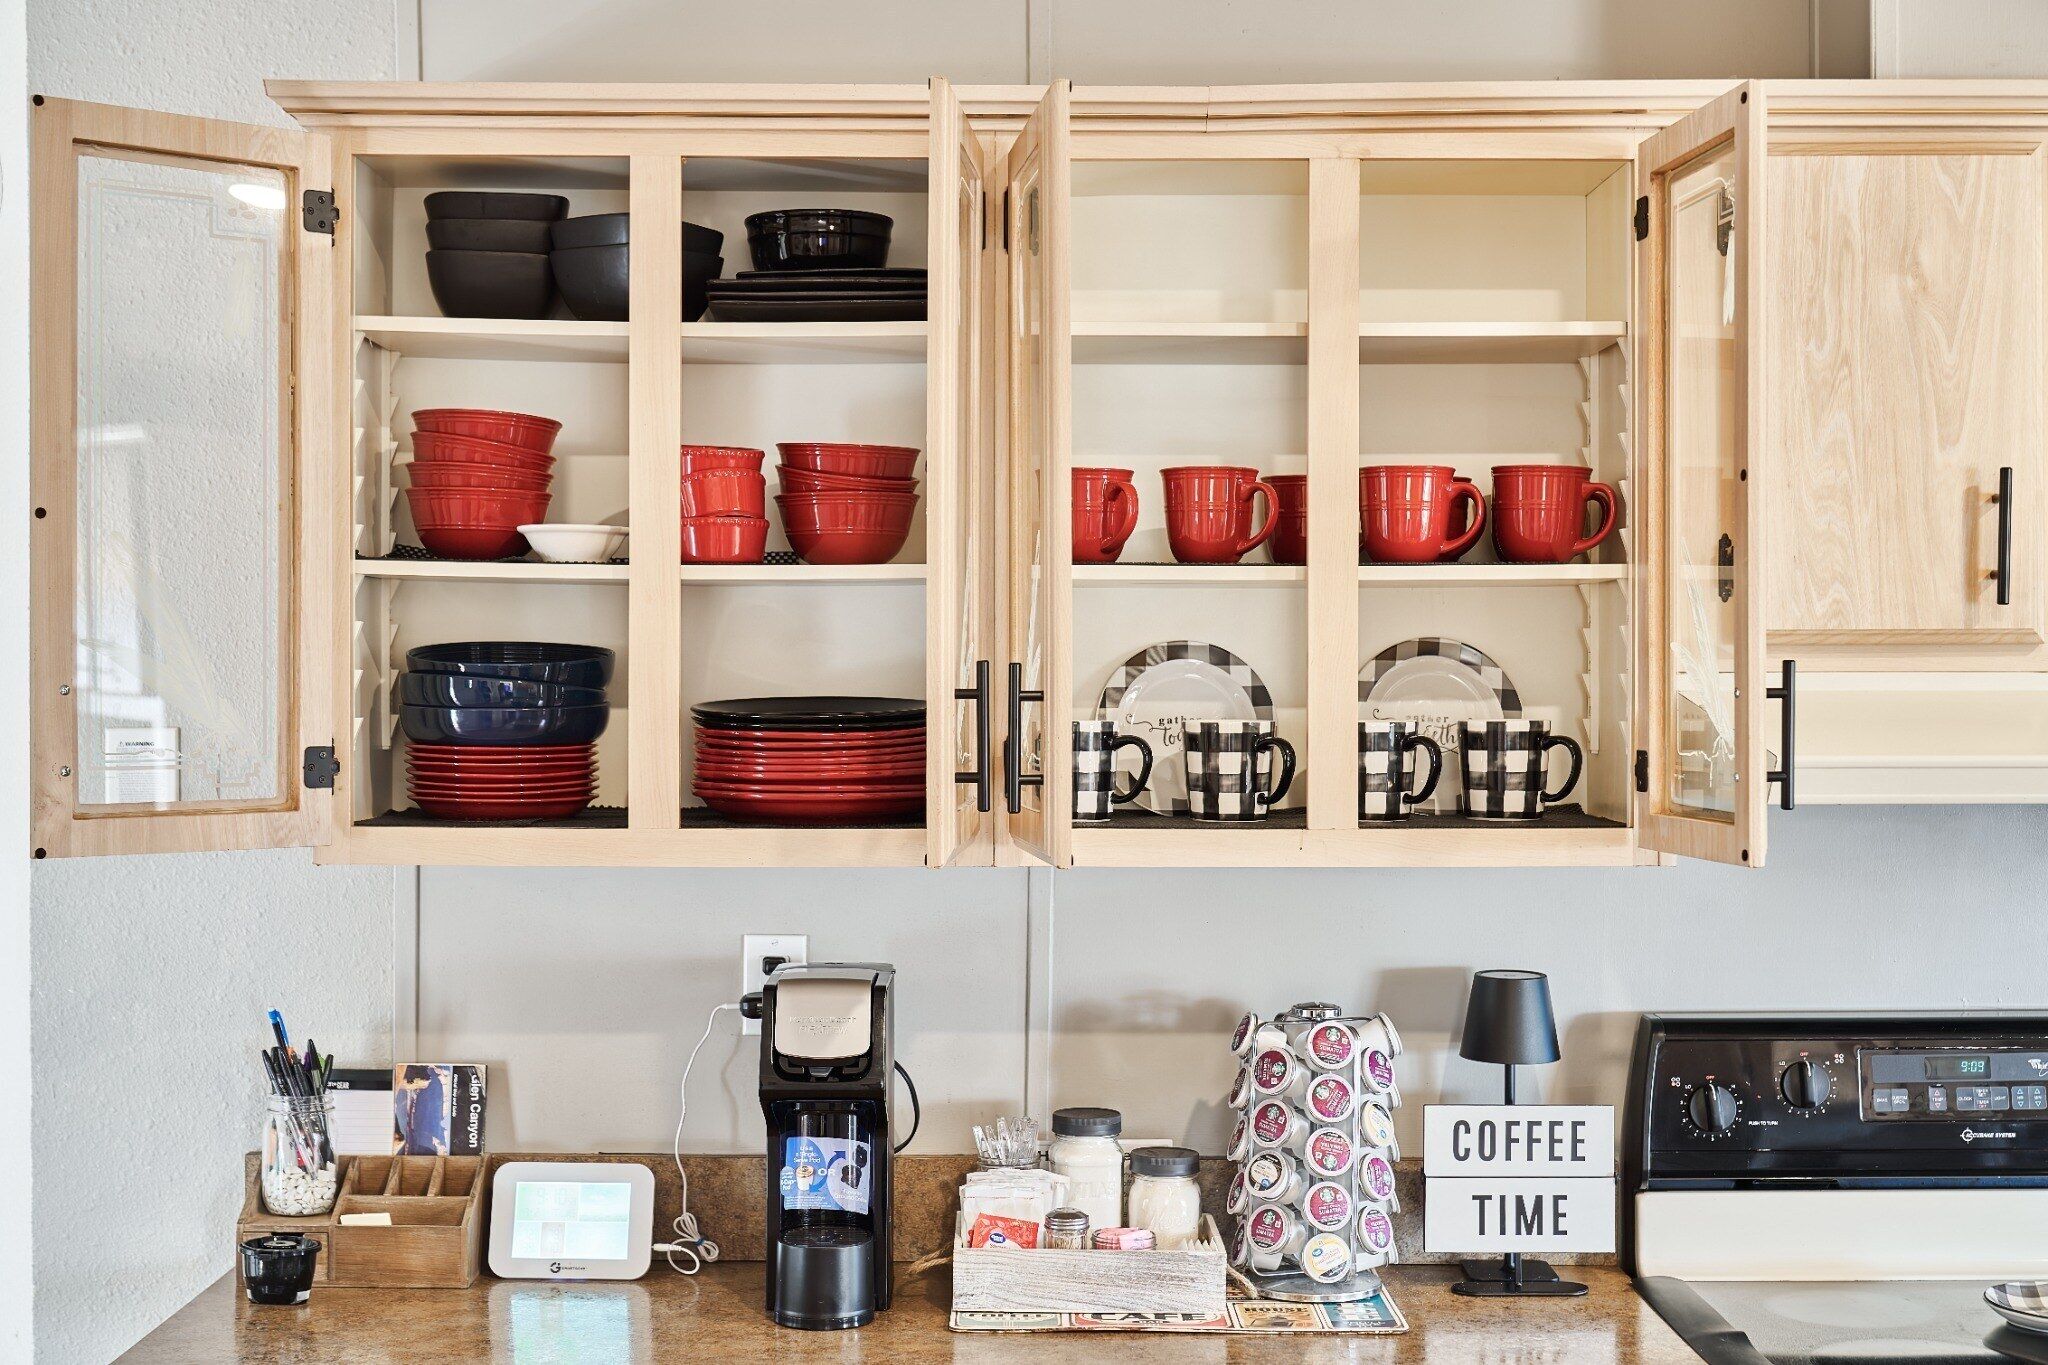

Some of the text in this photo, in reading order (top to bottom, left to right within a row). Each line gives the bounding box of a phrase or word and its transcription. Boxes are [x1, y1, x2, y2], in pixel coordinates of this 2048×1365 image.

[1961, 1060, 1985, 1073] 9:09
[467, 1103, 481, 1149] Canyon
[1452, 1119, 1586, 1162] COFFEE
[817, 1167, 836, 1177] OR
[1471, 1194, 1568, 1236] TIME
